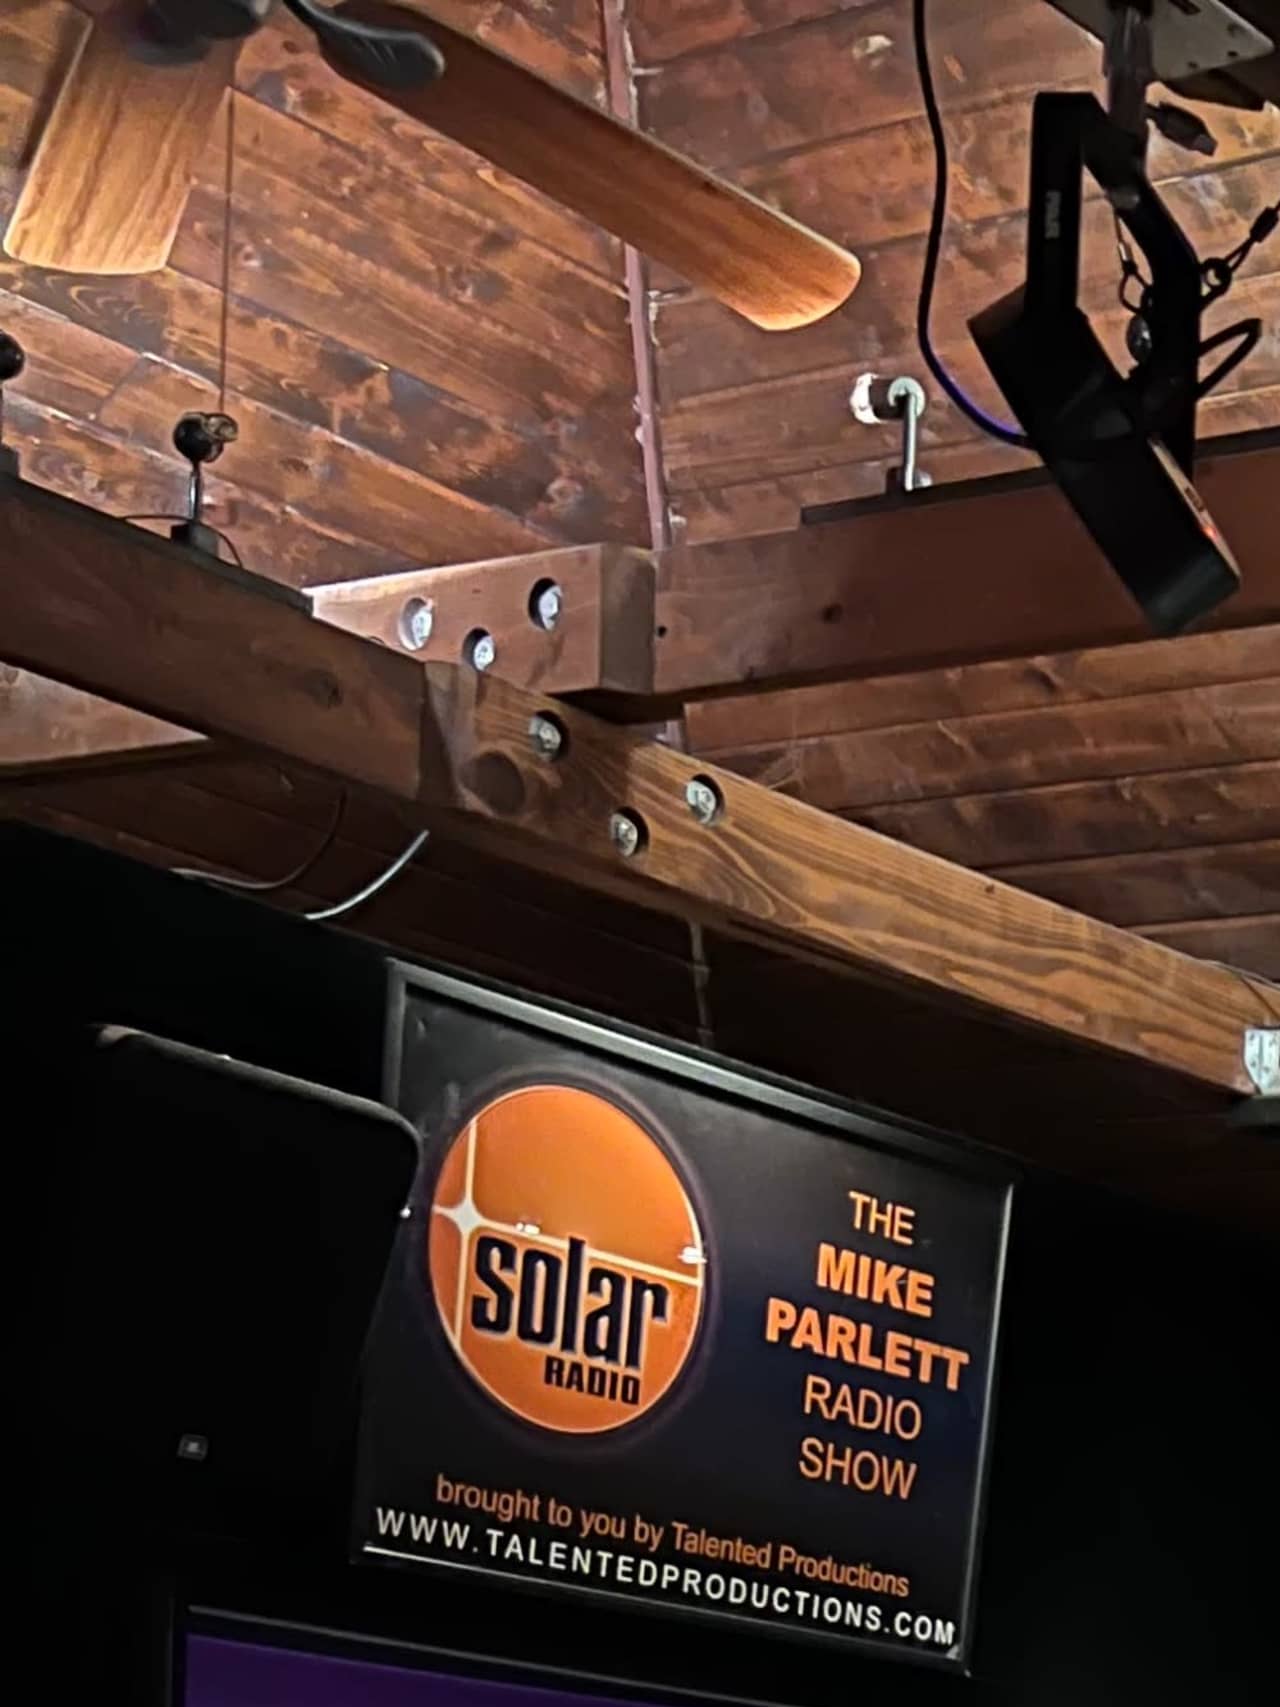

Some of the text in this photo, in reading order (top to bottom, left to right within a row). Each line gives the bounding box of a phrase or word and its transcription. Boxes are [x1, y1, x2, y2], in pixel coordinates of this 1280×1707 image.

[849, 1190, 915, 1245] THE
[471, 1236, 669, 1370] solar
[816, 1242, 935, 1318] MIKE
[544, 1355, 640, 1405] RADIO
[765, 1297, 969, 1391] PARLETT
[804, 1374, 922, 1440] RADIO
[799, 1437, 917, 1500] SHOW
[436, 1474, 909, 1598] brought to you by Talented Productions
[376, 1506, 956, 1646] WWW.TALENTEDPRODUCTIONS.COM
